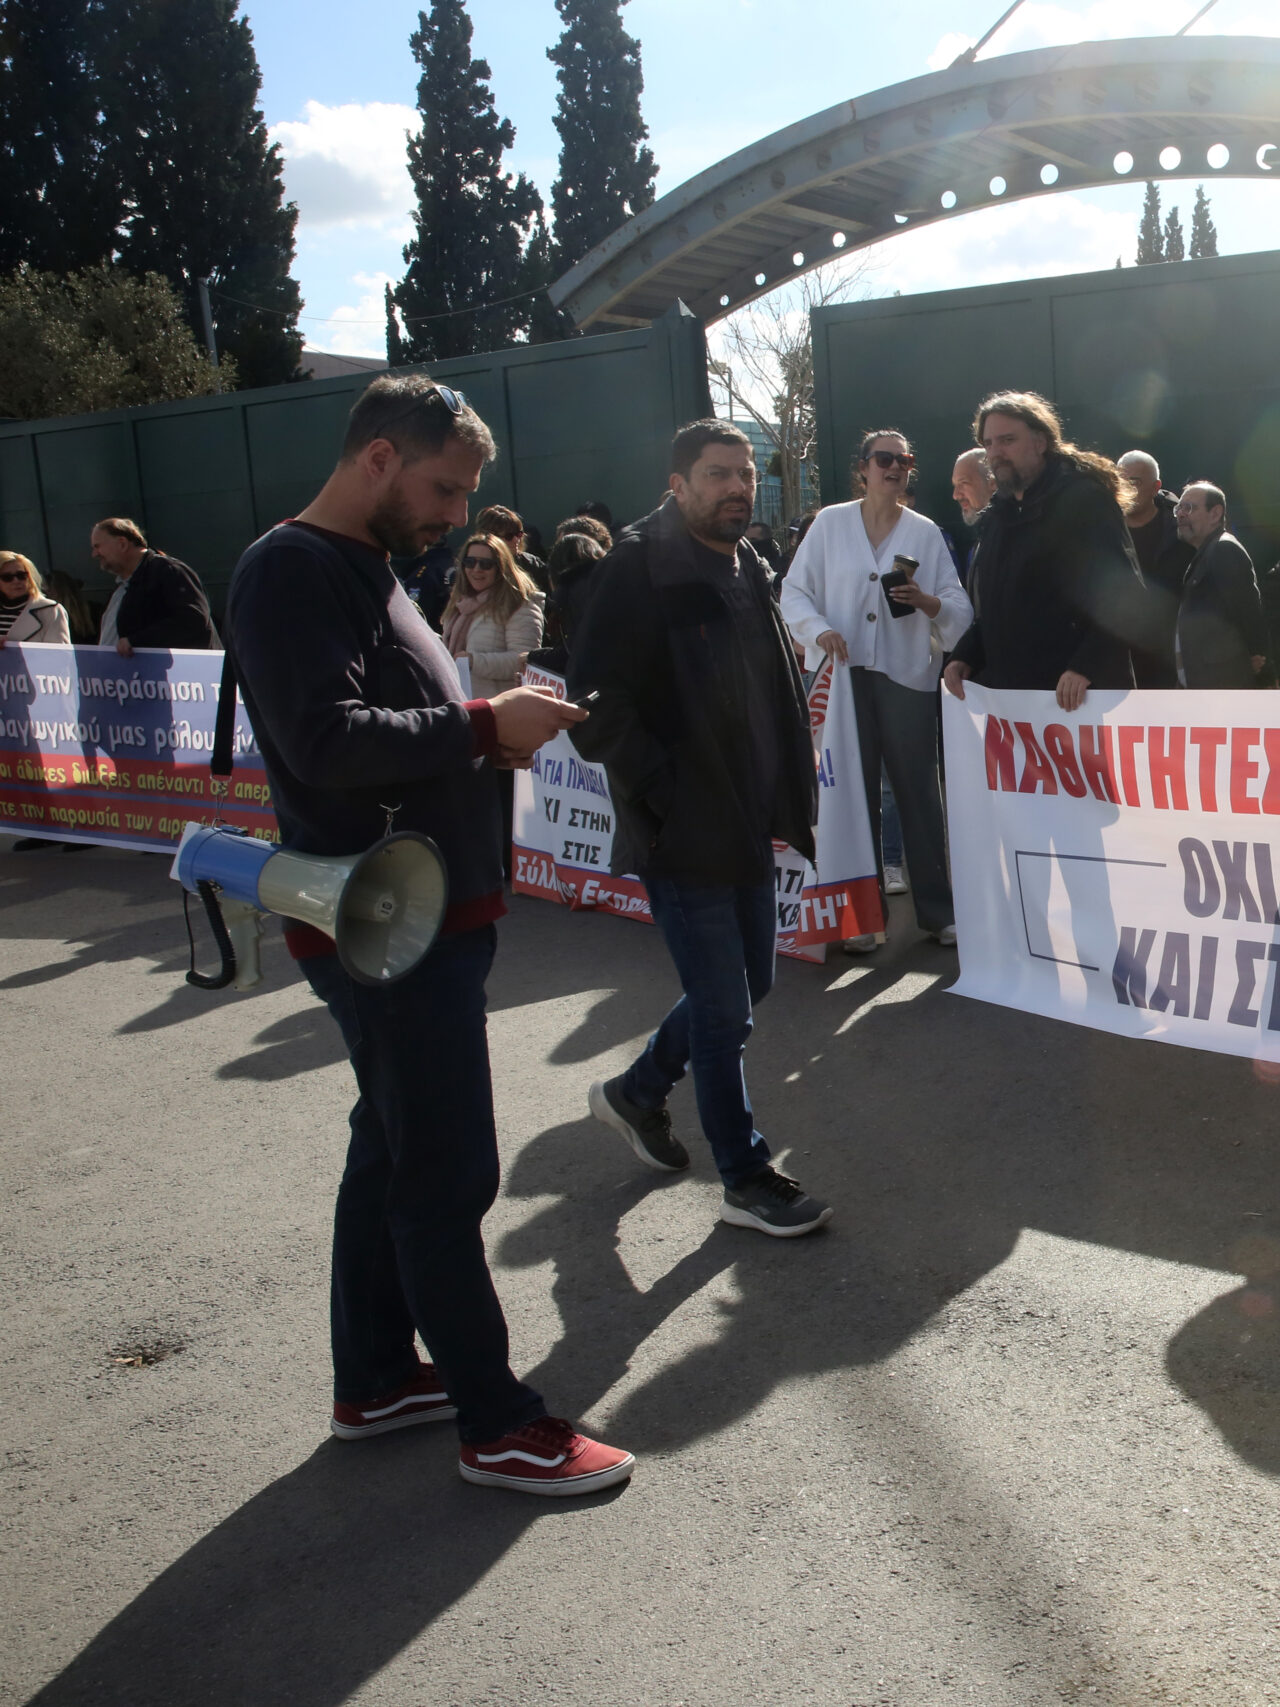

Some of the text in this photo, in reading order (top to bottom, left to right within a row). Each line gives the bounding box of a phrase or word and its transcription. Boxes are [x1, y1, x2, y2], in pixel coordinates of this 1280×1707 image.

[36, 673, 71, 696] την
[79, 672, 205, 706] υπεράσπιση
[109, 722, 146, 752] μας
[155, 720, 215, 754] ρόλου
[17, 759, 67, 784] άδικες
[72, 762, 131, 790] διώξεις
[137, 770, 204, 795] απέναντι
[235, 784, 275, 808] απερ
[544, 759, 563, 786] ΓΙΑ
[0, 801, 17, 817] τε
[21, 803, 45, 818] την
[50, 806, 120, 829] παρουσία
[125, 813, 153, 831] των
[544, 796, 611, 834] ΧΙ ΣΤΗΝ
[562, 840, 602, 865] ΣΤΙΣ
[1178, 836, 1280, 925] ΟΧΙ
[1112, 926, 1219, 1021] ΚΑΙ
